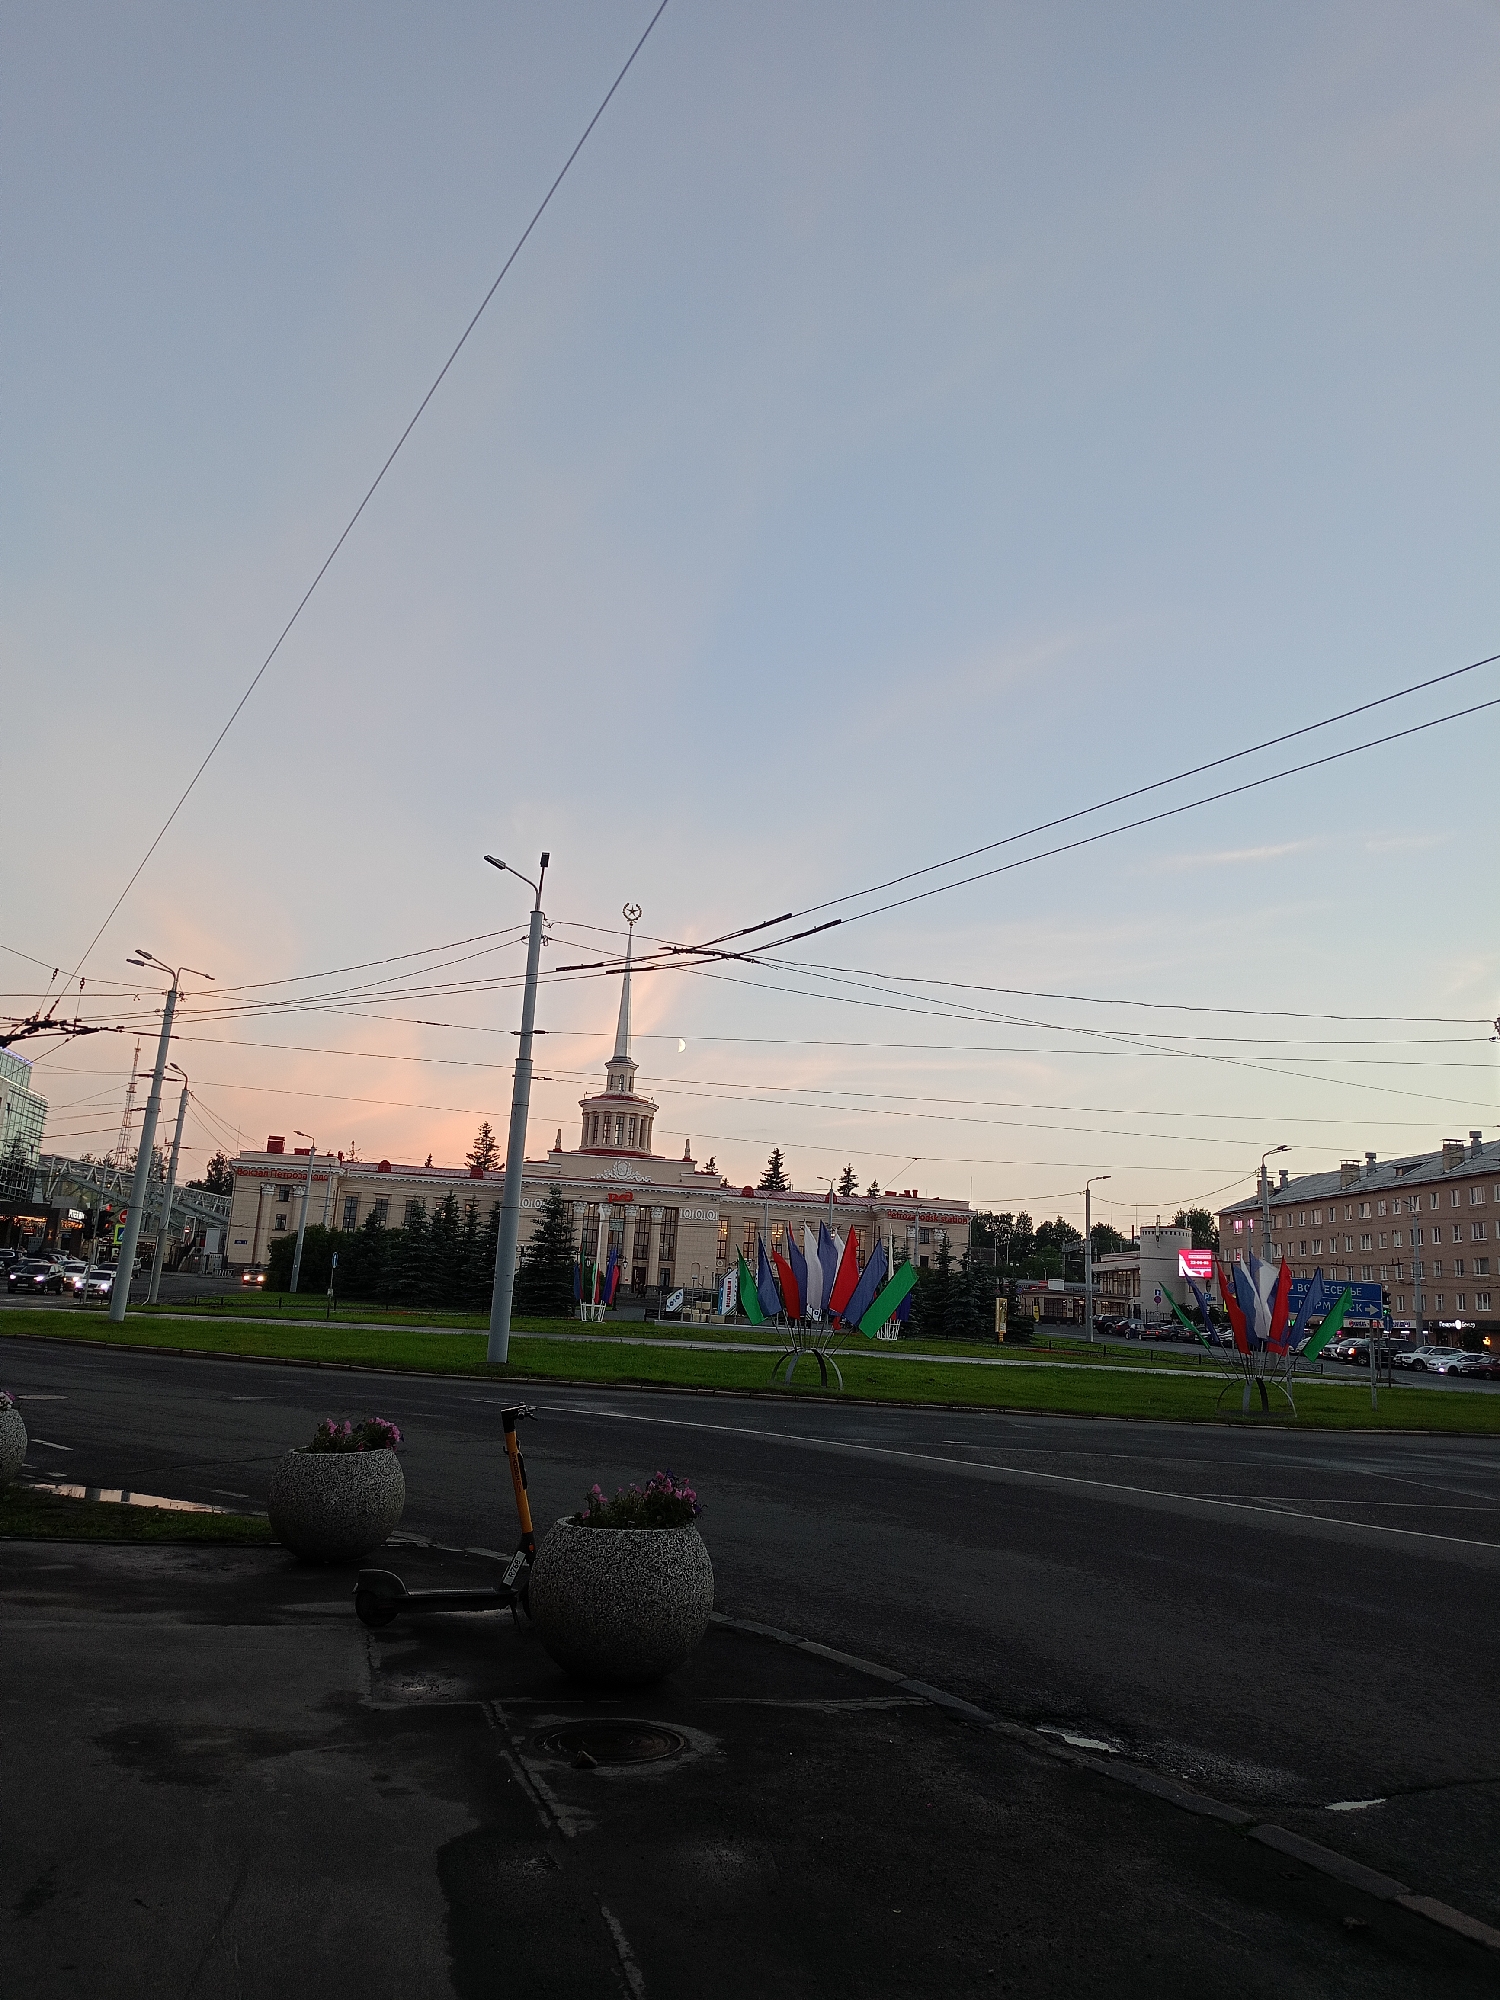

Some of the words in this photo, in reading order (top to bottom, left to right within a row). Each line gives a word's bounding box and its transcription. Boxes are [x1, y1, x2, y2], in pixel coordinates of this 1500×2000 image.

[237, 1167, 268, 1177] Вокзал
[270, 1169, 330, 1181] Петрозаодс
[887, 1210, 938, 1222] Petrozaodsk
[941, 1215, 968, 1225] station
[1297, 1283, 1362, 1296] ВОЕСЕЬЕ
[1298, 1299, 1363, 1313] МРМСК
